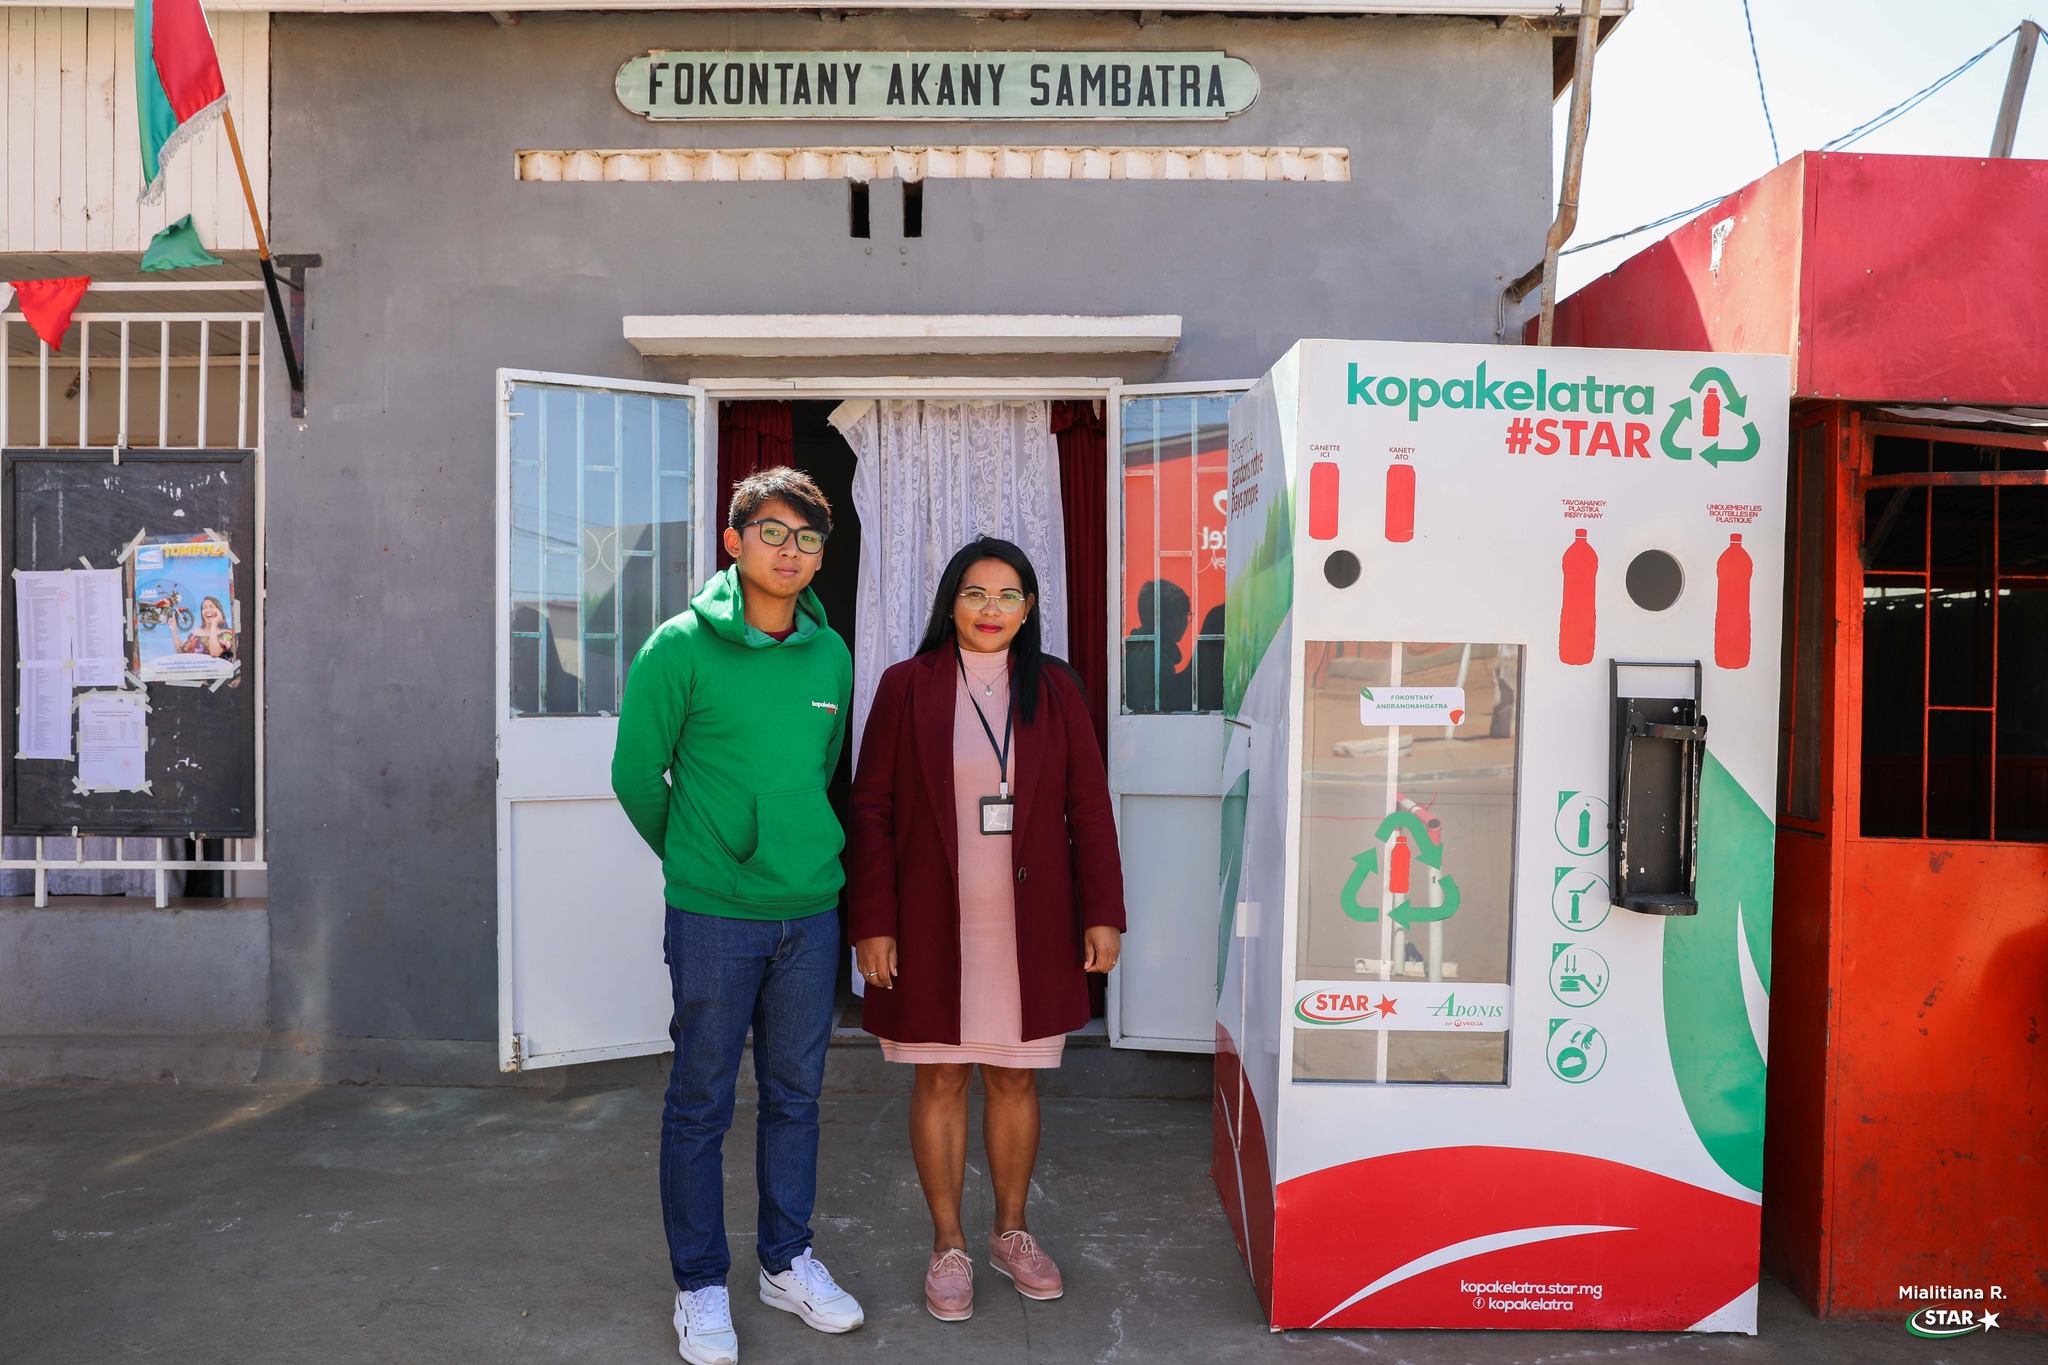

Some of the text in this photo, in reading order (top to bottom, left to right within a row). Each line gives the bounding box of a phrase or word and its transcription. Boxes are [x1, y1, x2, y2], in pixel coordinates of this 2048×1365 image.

[649, 62, 1226, 108] FOKONTANY AKANY SAMBATRA
[1347, 359, 1655, 422] kopakelatra
[1505, 417, 1652, 459] #STAR
[1309, 444, 1341, 452] CANETTE
[1388, 446, 1416, 454] KANETY
[1394, 453, 1409, 461] ATO
[1561, 499, 1607, 507] TAVOAHANGY
[1568, 505, 1600, 513] PLASTIKA
[1709, 510, 1749, 518] BOUTEILLES
[1716, 516, 1753, 524] PLASTIQUE
[1315, 993, 1370, 1012] STAR
[1460, 1280, 1603, 1300] kopakelatra.star.mg
[1488, 1297, 1574, 1313] kopakelatra
